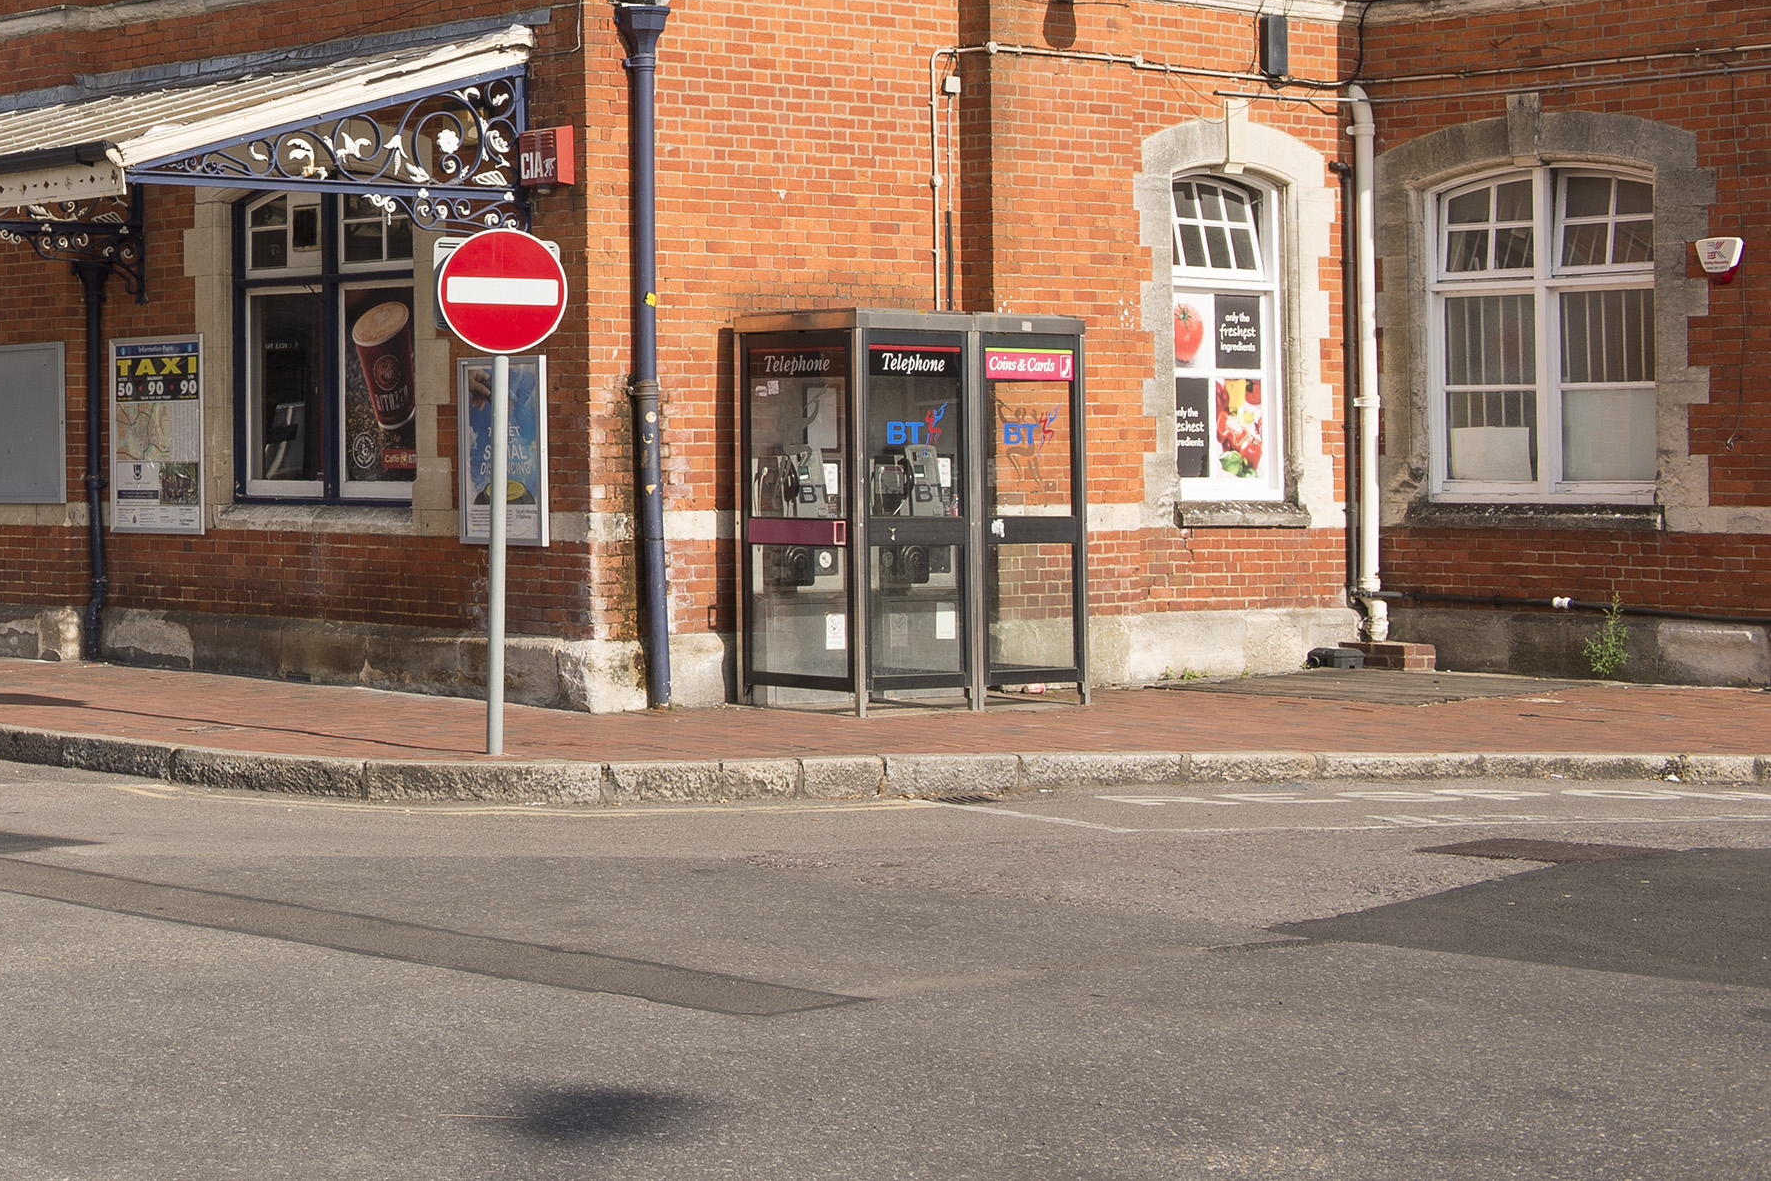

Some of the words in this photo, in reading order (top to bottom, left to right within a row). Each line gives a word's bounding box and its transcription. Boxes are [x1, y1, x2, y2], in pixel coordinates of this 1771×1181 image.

[521, 151, 543, 179] CIA
[1225, 313, 1239, 324] only
[1239, 312, 1251, 323] the
[1219, 323, 1257, 341] freshest
[138, 345, 162, 353] Information
[162, 345, 174, 353] Point
[1220, 342, 1256, 353] ingredients
[117, 356, 197, 376] TAXI
[764, 355, 830, 376] Telephone
[881, 353, 945, 374] Telephone
[989, 356, 1017, 371] Coins
[1017, 357, 1026, 371] &
[1026, 357, 1055, 372] Cards
[118, 382, 133, 397] 50
[148, 381, 164, 395] 90
[180, 380, 197, 394] 90
[1188, 407, 1199, 418] the
[487, 426, 521, 438] TET
[887, 421, 925, 445] BT
[1003, 423, 1039, 445] BT
[1176, 421, 1205, 433] eshest
[1177, 436, 1204, 447] redients
[483, 444, 528, 461] SIAL
[480, 461, 532, 476] DISNCING
